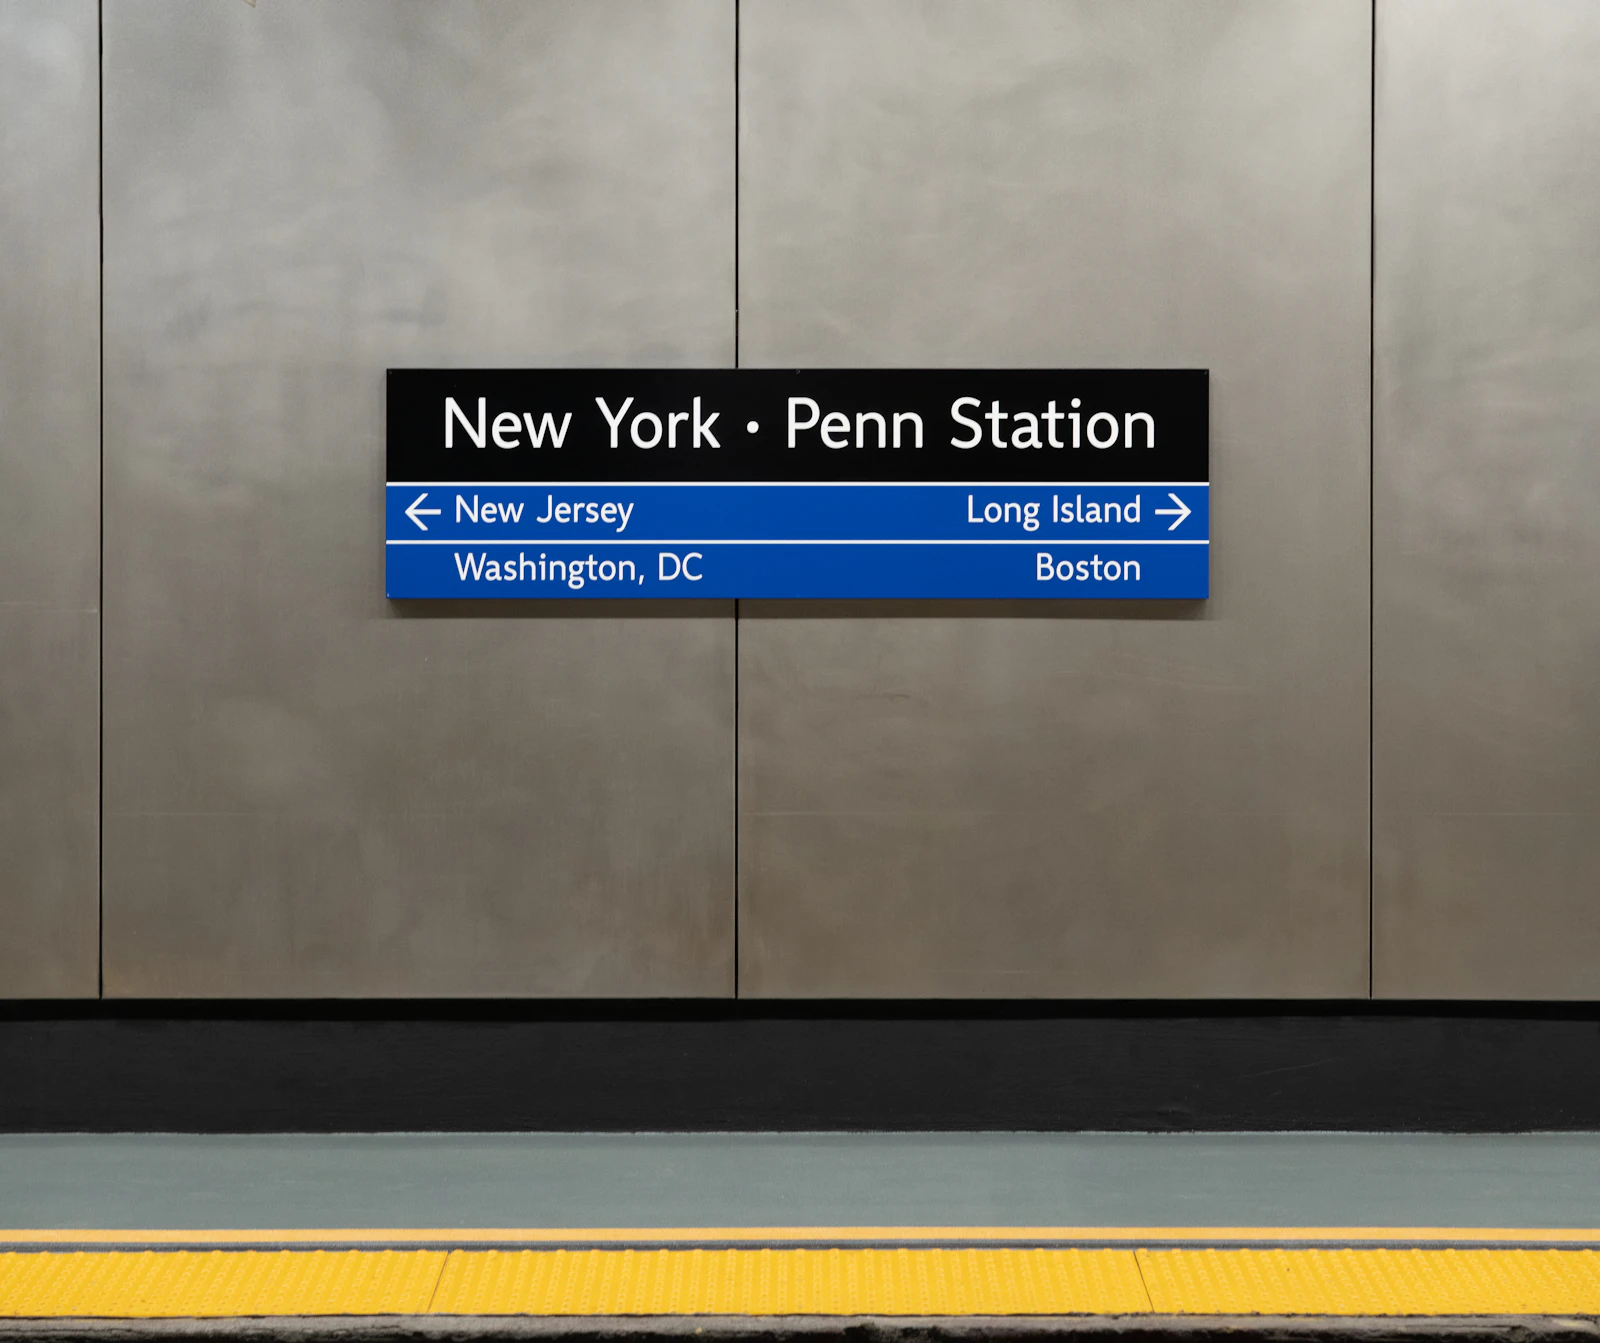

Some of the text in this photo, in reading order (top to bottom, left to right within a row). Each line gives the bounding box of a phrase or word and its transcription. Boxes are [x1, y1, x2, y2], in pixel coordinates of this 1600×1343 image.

[445, 396, 1155, 449] New York Penn Station
[455, 494, 635, 533] New Jersey
[967, 494, 1141, 532] Long Island
[453, 551, 703, 590] Washington, DC
[1036, 552, 1141, 581] Boston
